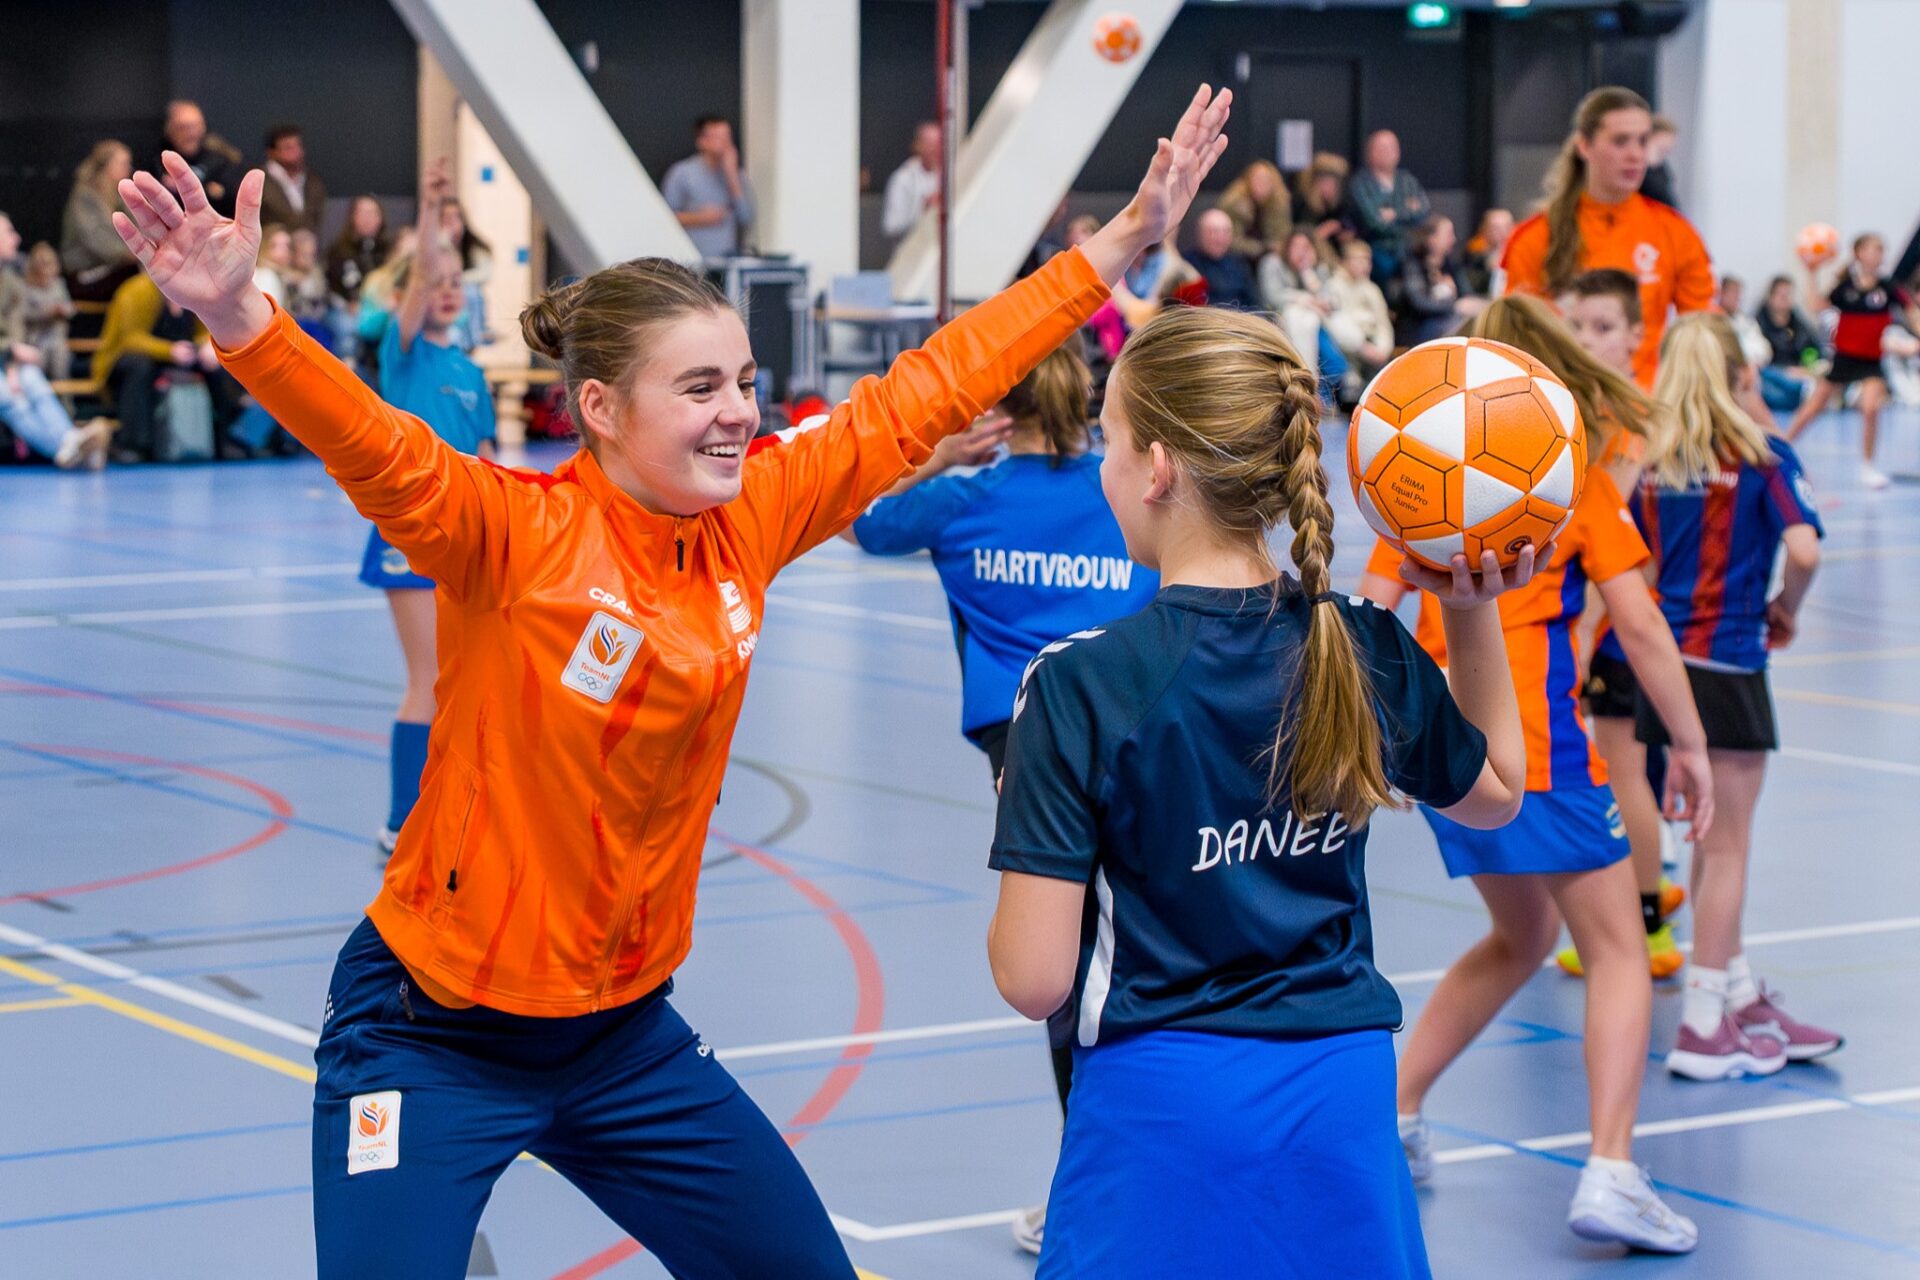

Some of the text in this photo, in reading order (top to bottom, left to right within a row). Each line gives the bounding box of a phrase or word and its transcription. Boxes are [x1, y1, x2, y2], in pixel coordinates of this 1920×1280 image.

[1391, 482, 1428, 505] Equal Pro
[1400, 474, 1425, 492] ERIMA
[1394, 497, 1418, 512] Junior
[974, 548, 1133, 591] HARTVROUW
[1191, 810, 1348, 872] DANEE
